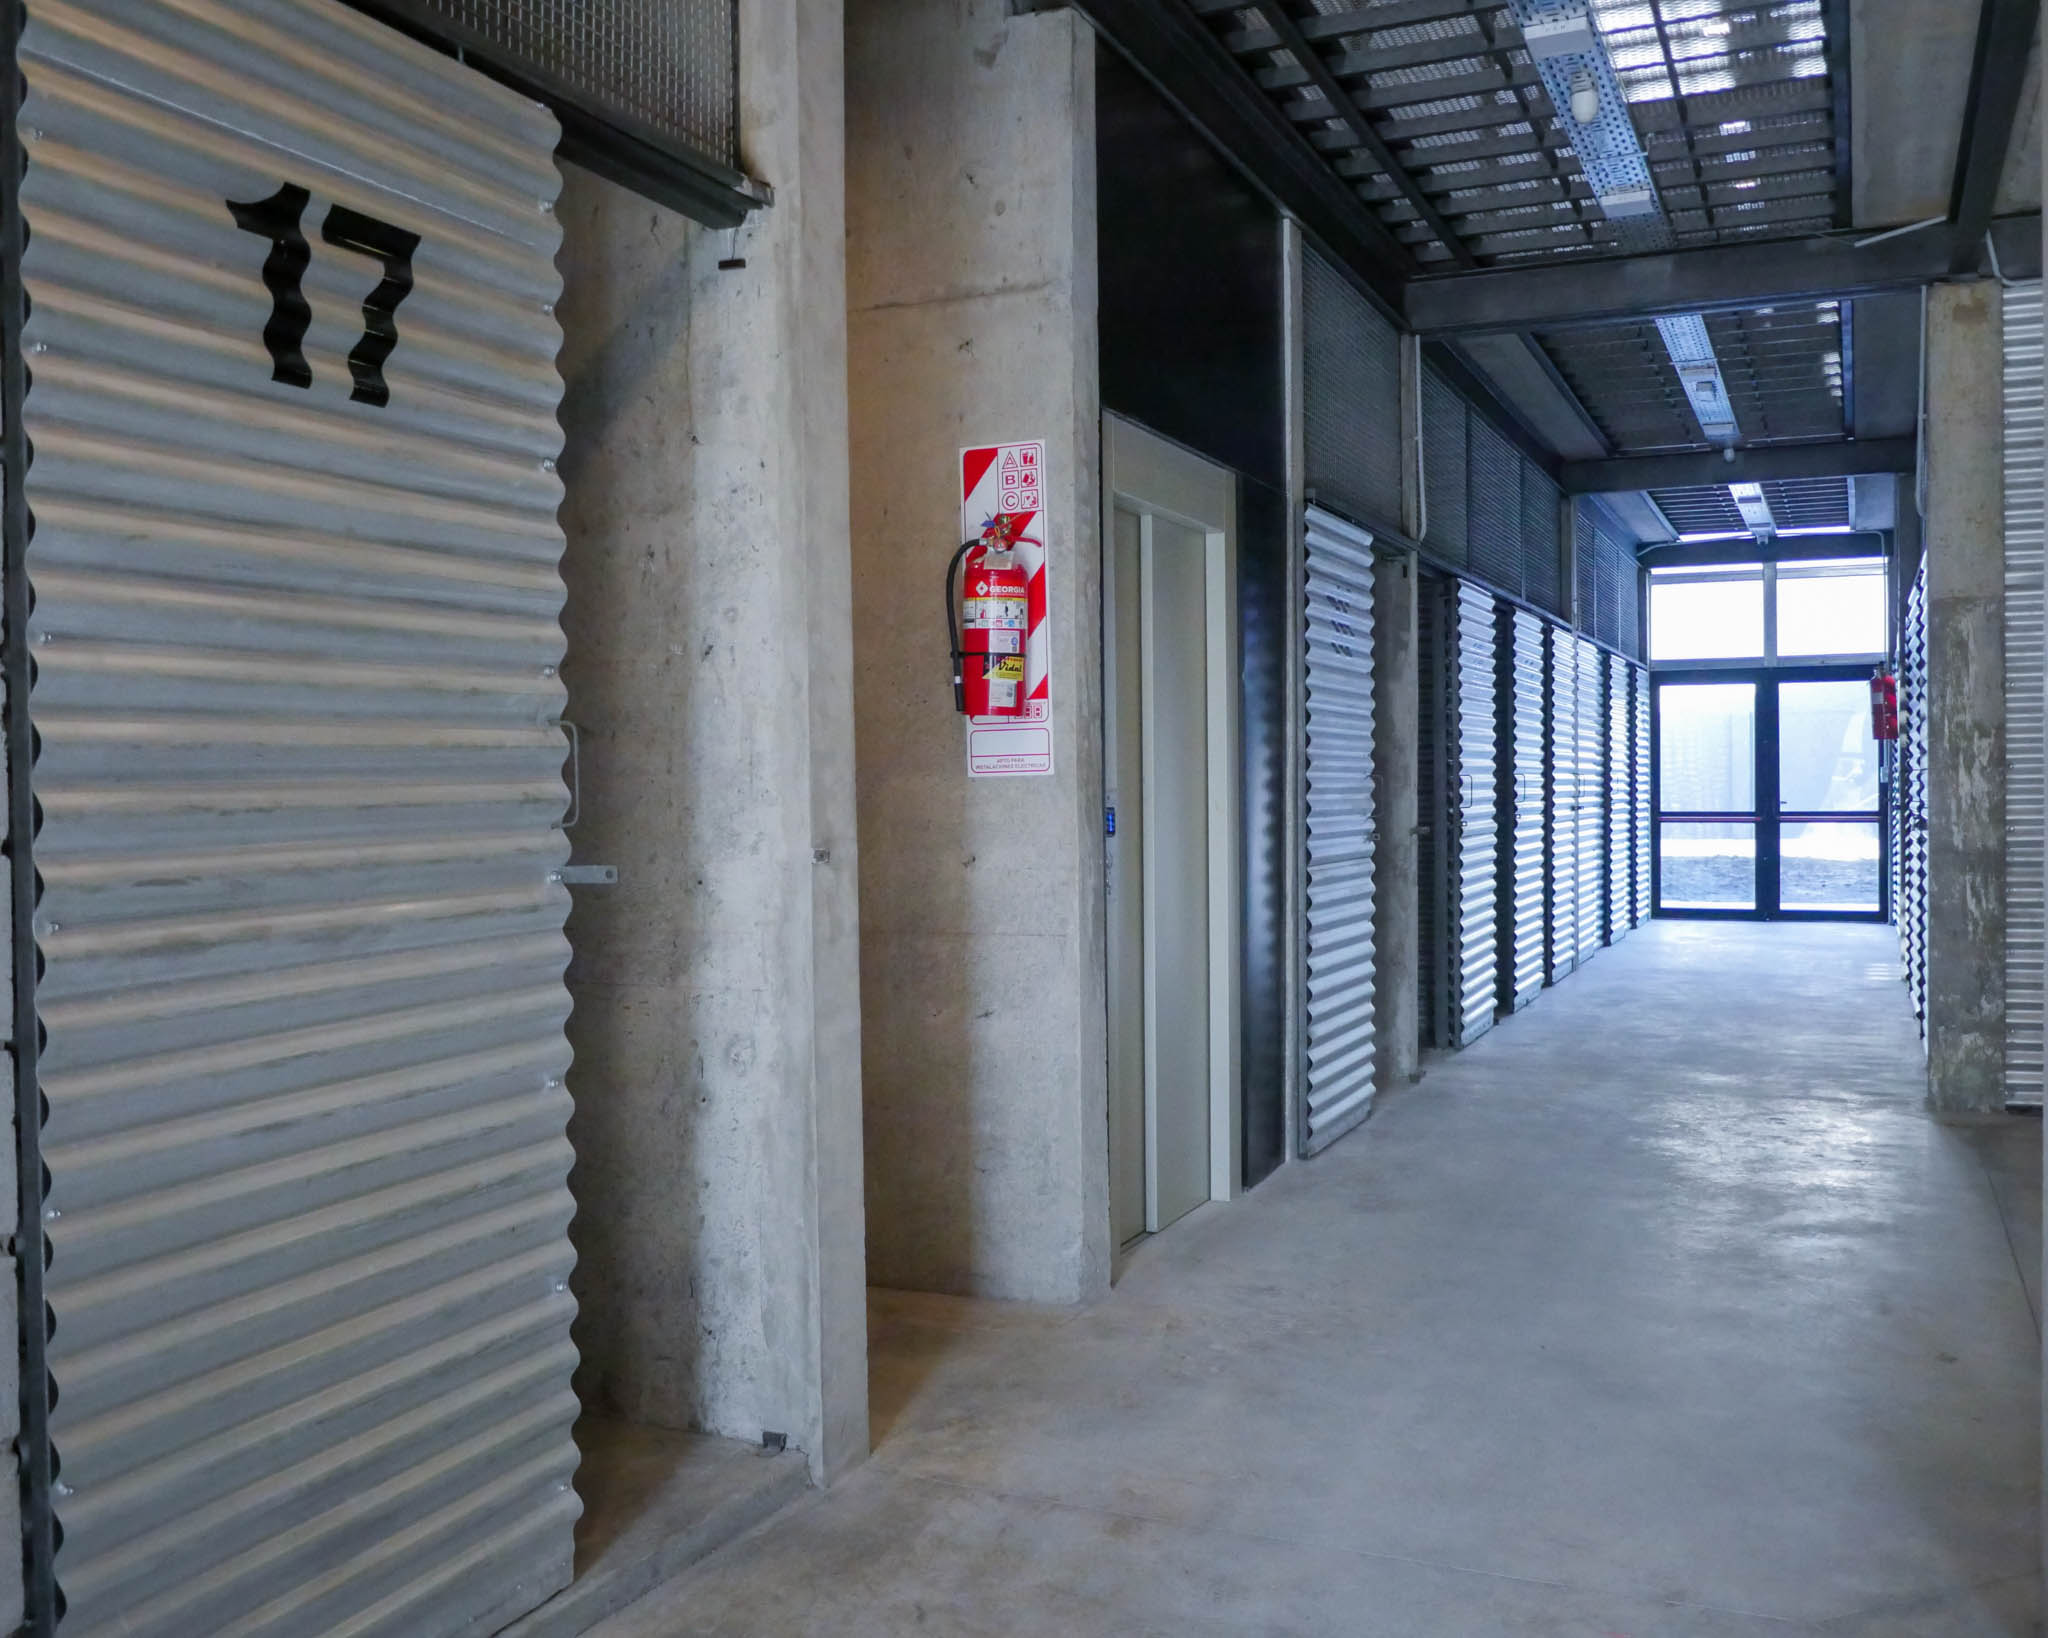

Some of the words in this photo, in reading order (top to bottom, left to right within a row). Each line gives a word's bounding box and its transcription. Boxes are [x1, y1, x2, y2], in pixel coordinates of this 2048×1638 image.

[226, 182, 422, 408] 17
[1005, 475, 1015, 485] B
[1005, 495, 1016, 507] C
[989, 585, 1025, 594] GEORGIA
